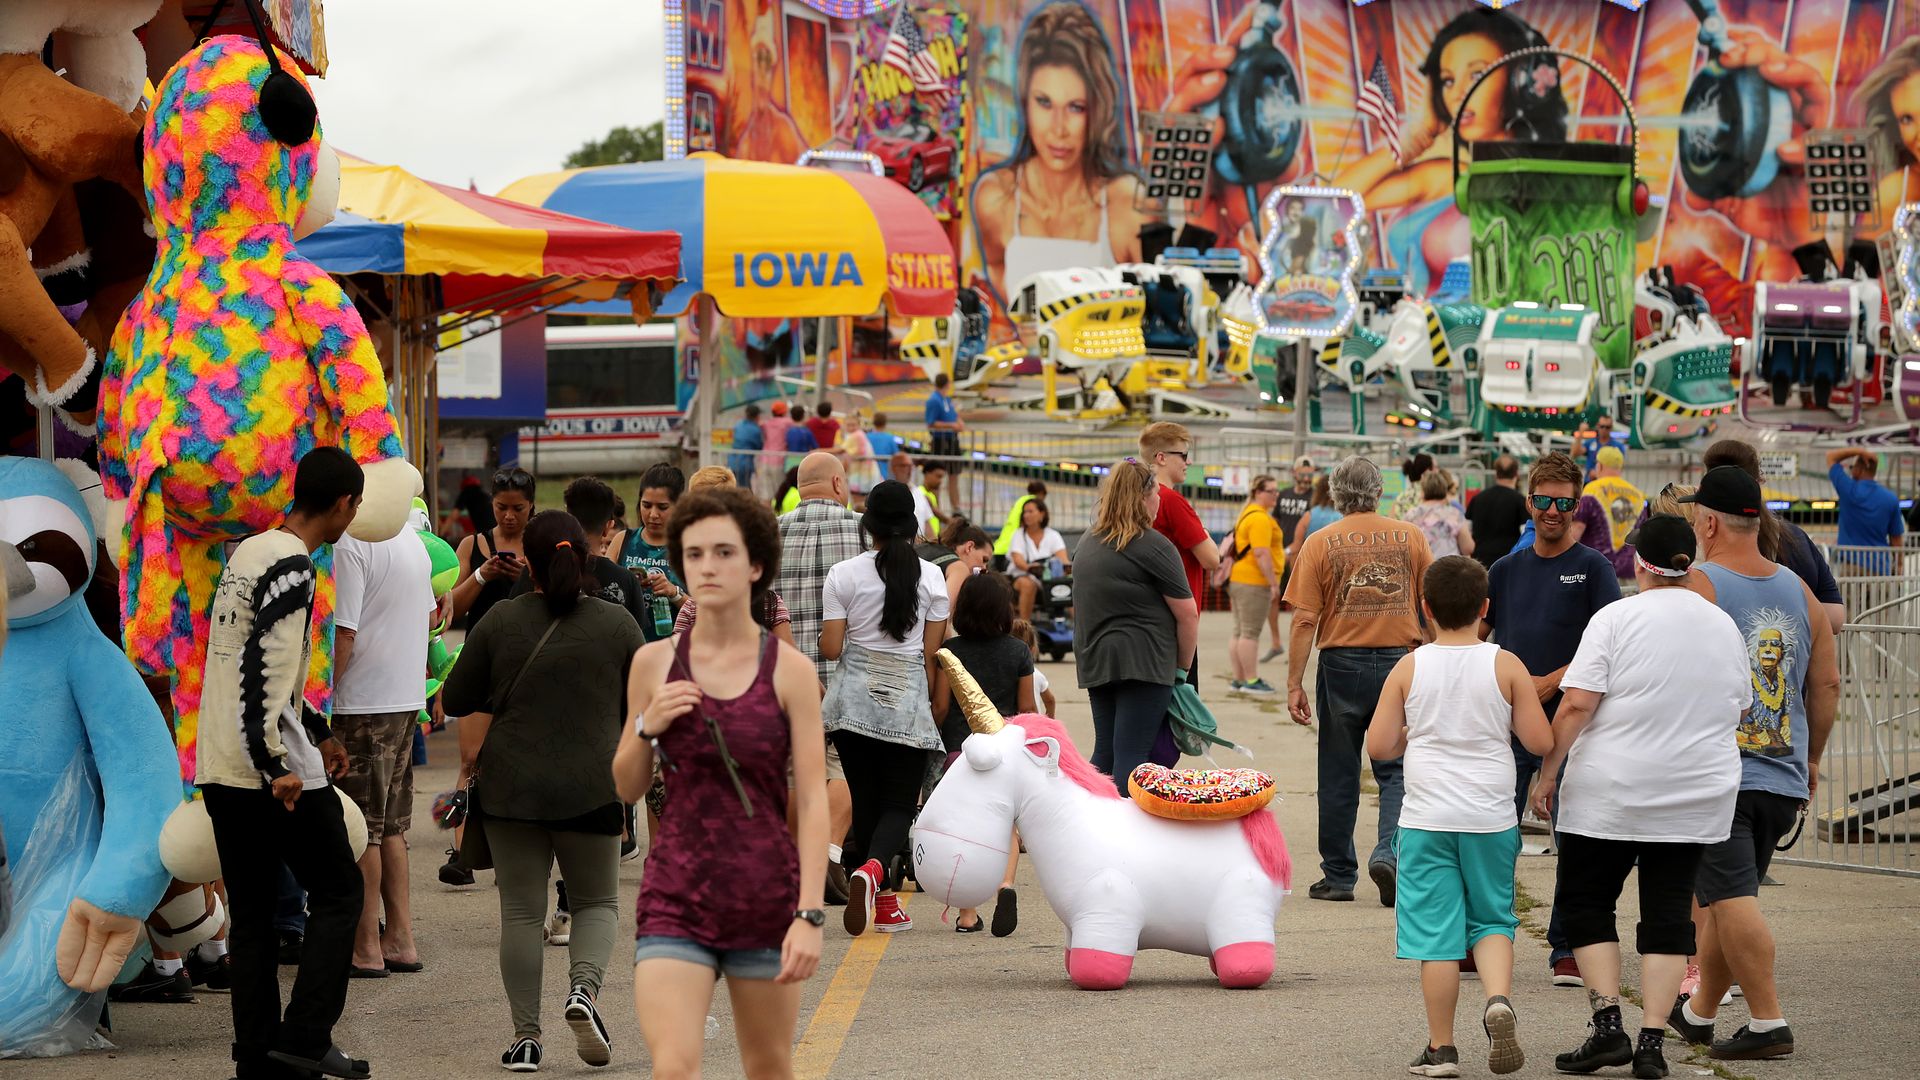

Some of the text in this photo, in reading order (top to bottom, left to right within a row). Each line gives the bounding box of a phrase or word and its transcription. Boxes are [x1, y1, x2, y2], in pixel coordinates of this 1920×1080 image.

[733, 252, 956, 290] IOWA STATE
[590, 417, 618, 433] OF
[622, 415, 671, 433] IOWA
[1325, 529, 1409, 550] HONU
